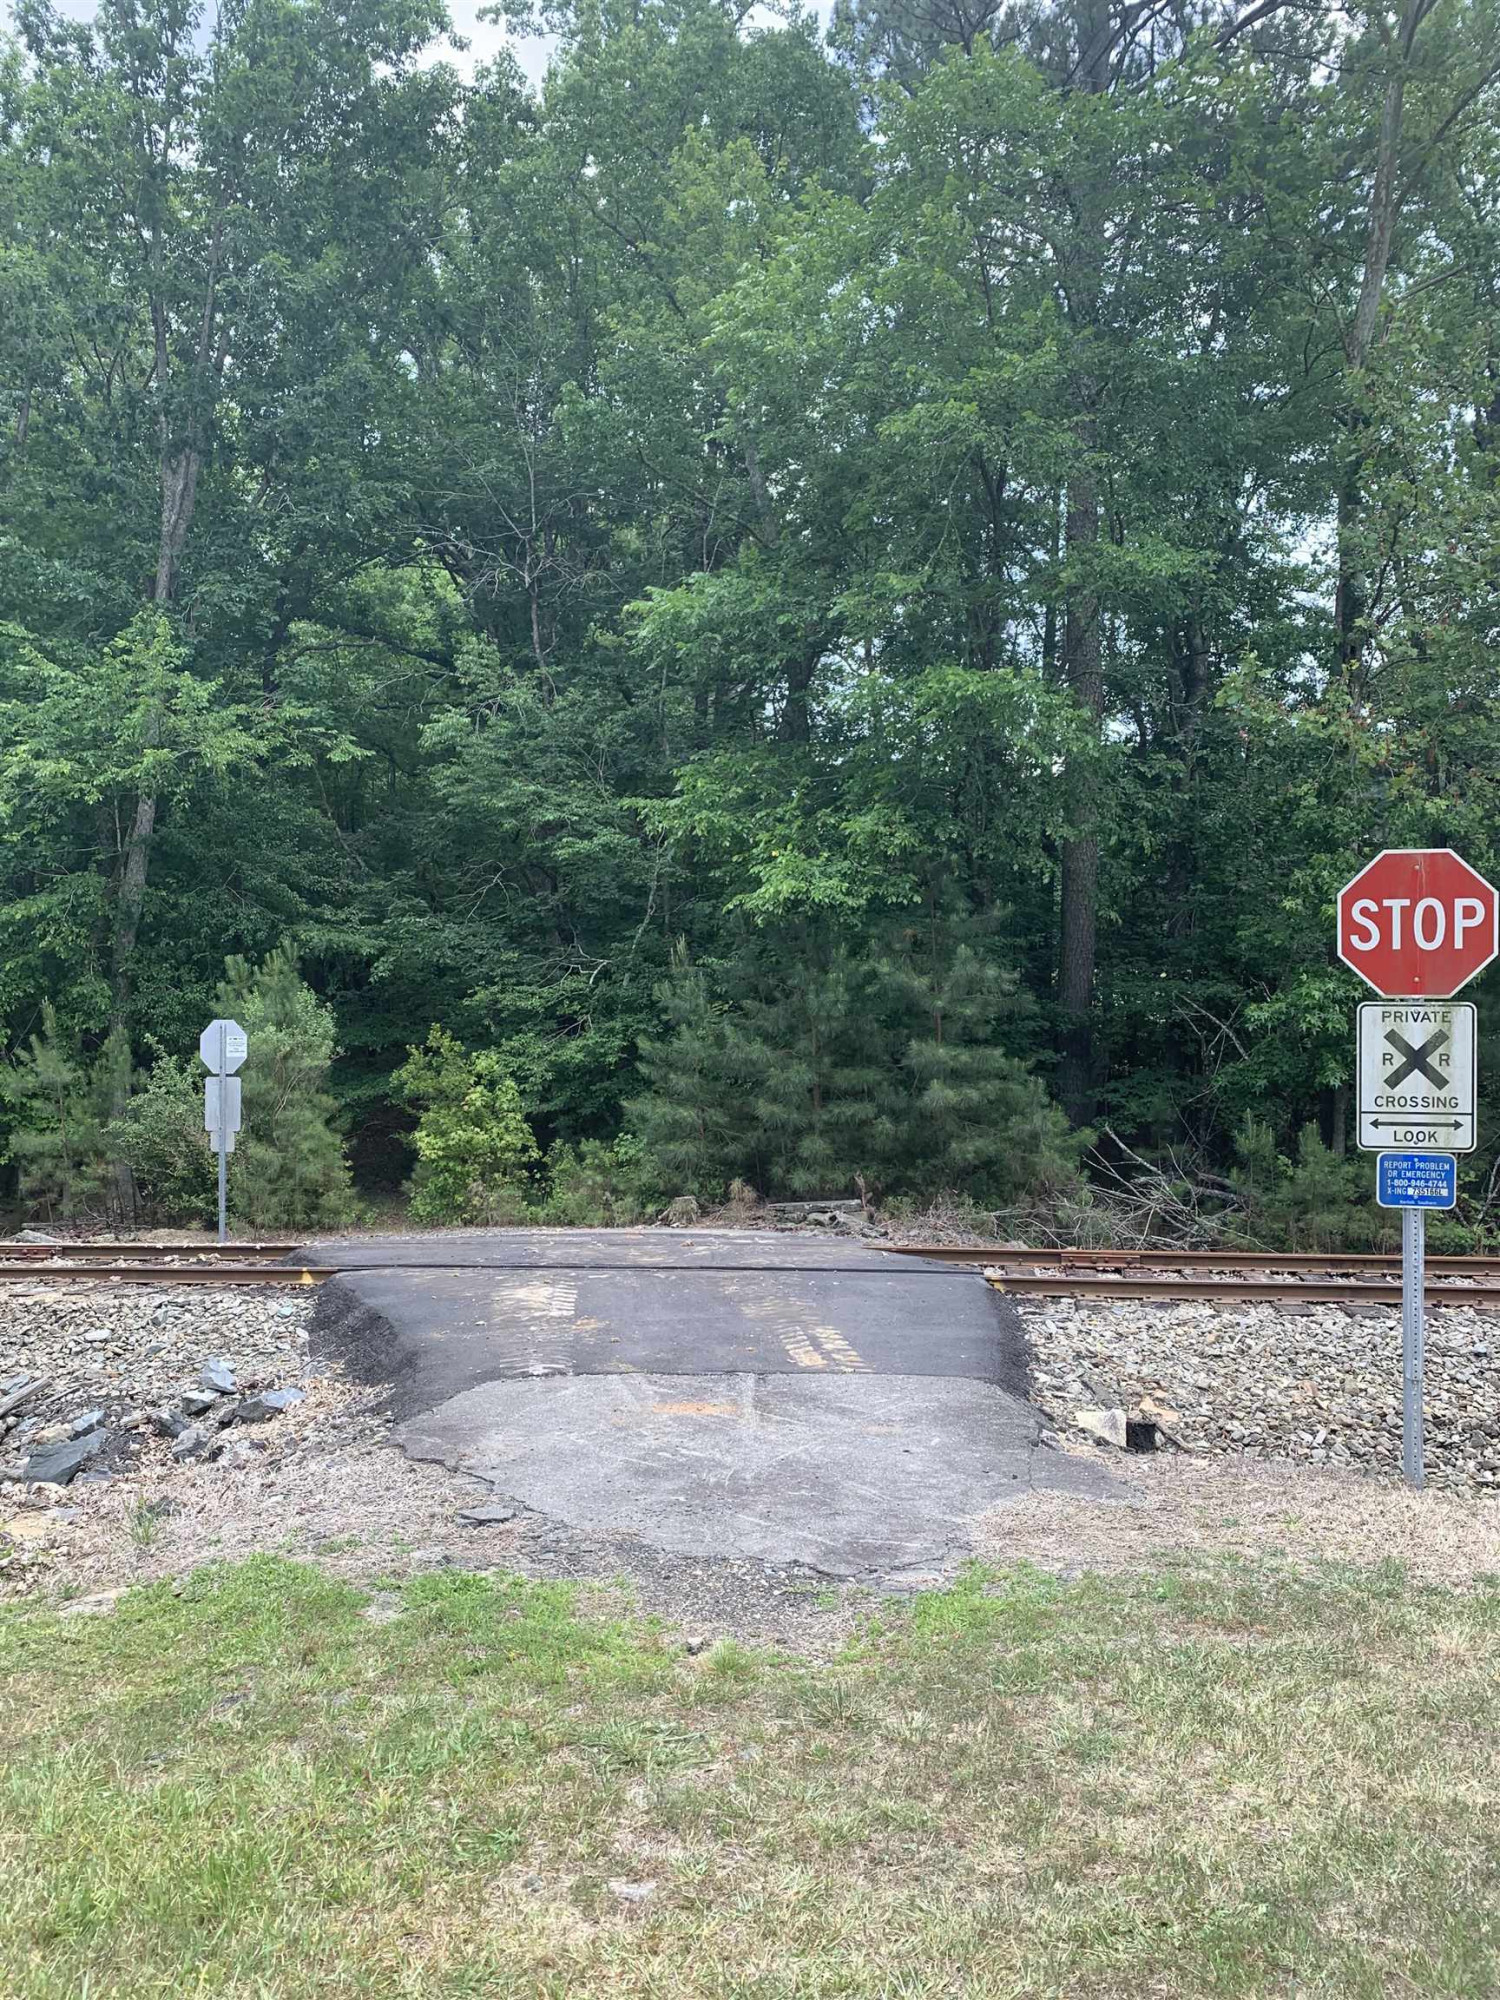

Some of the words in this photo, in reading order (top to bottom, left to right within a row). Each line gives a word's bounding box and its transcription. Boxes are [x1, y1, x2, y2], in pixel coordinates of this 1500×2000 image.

[1350, 898, 1485, 950] STOP
[1381, 1011, 1451, 1023] PRIVATE
[1382, 1053, 1394, 1066] R
[1439, 1053, 1450, 1066] R
[1374, 1095, 1459, 1108] CROSSING
[1393, 1130, 1438, 1143] LOOK
[1384, 1161, 1411, 1169] REPORT
[1415, 1162, 1450, 1170] PROBLEM
[1401, 1170, 1446, 1178] EMERGENCY
[1387, 1179, 1447, 1187] 1-800-946-4744
[1387, 1187, 1406, 1195] X-ING
